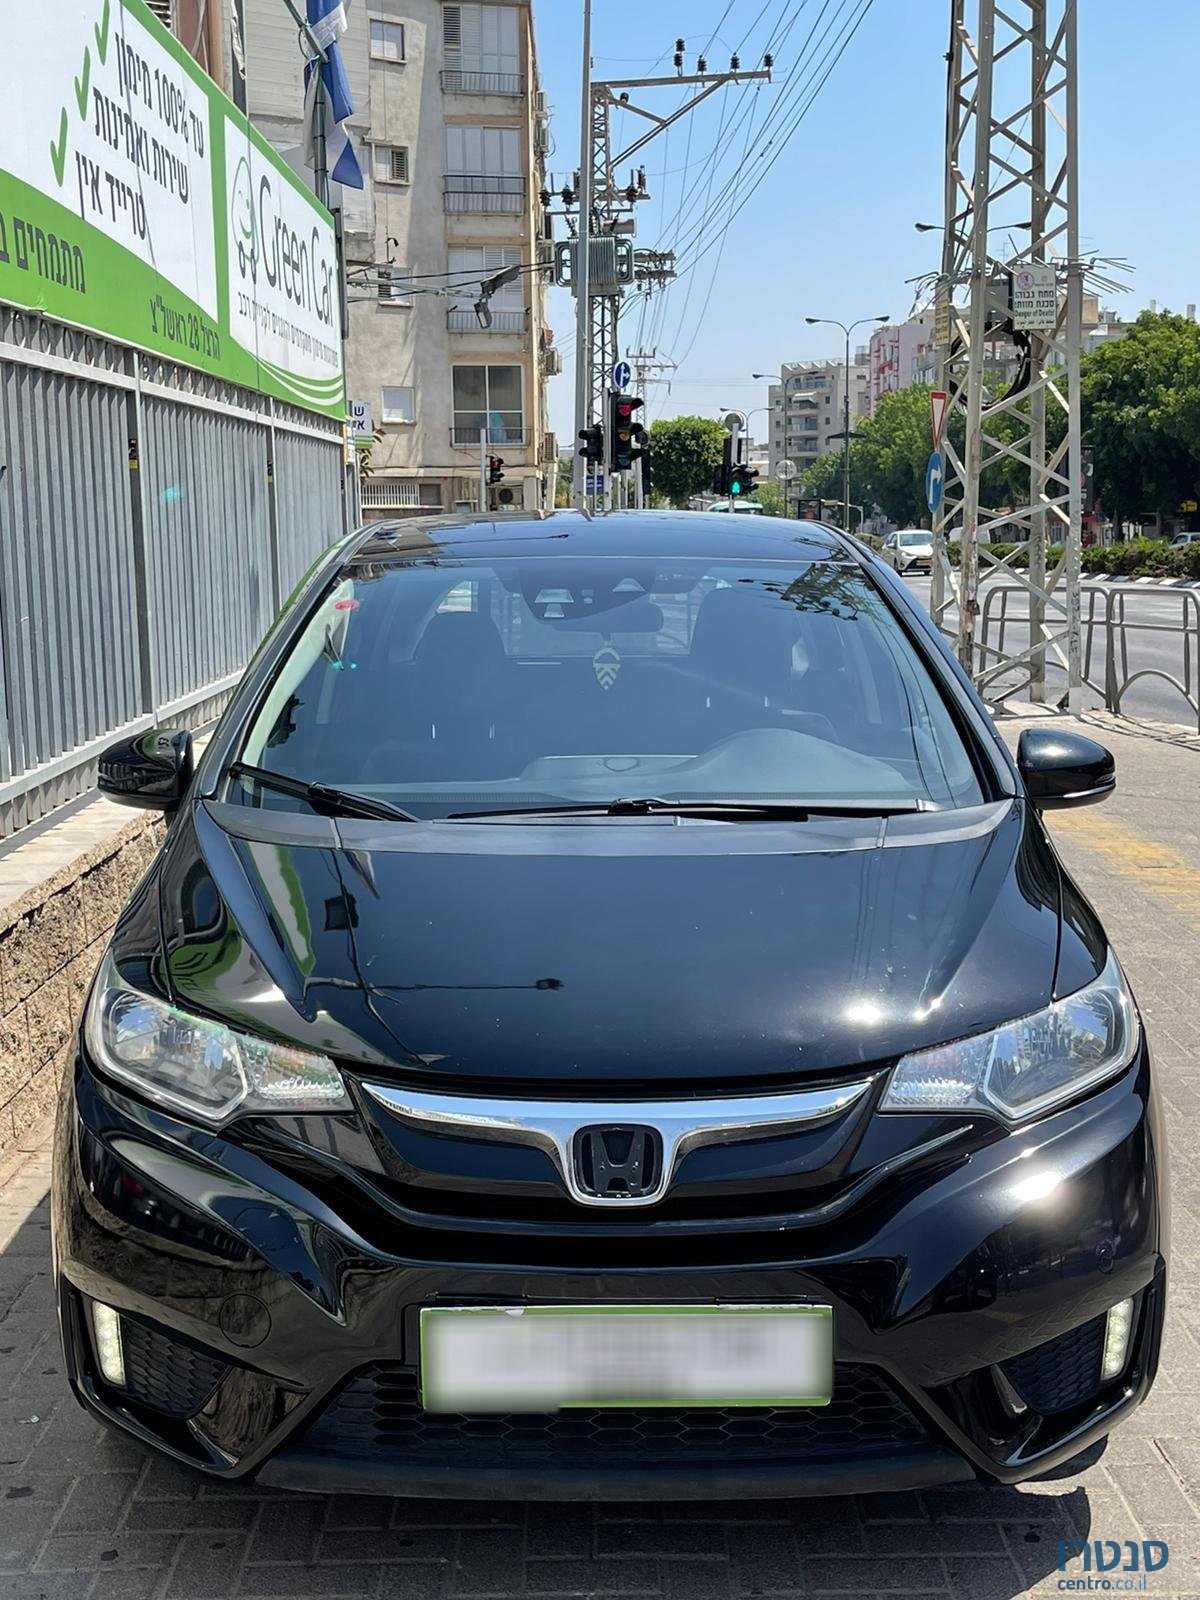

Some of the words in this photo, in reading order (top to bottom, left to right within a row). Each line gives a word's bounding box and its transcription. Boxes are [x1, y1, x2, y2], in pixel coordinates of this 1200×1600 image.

[115, 32, 153, 110] מימון
[92, 86, 150, 175] ואמינות
[154, 68, 189, 144] 100%
[189, 109, 205, 158] עד
[75, 150, 103, 220] אין
[151, 137, 189, 204] שירות
[104, 171, 146, 240] טרייד
[13, 216, 86, 294] מתמחים
[259, 174, 311, 312] Green
[311, 226, 333, 327] Car
[187, 312, 200, 351] 28
[1036, 300, 1054, 308] סכנת
[200, 317, 221, 361] הרצל
